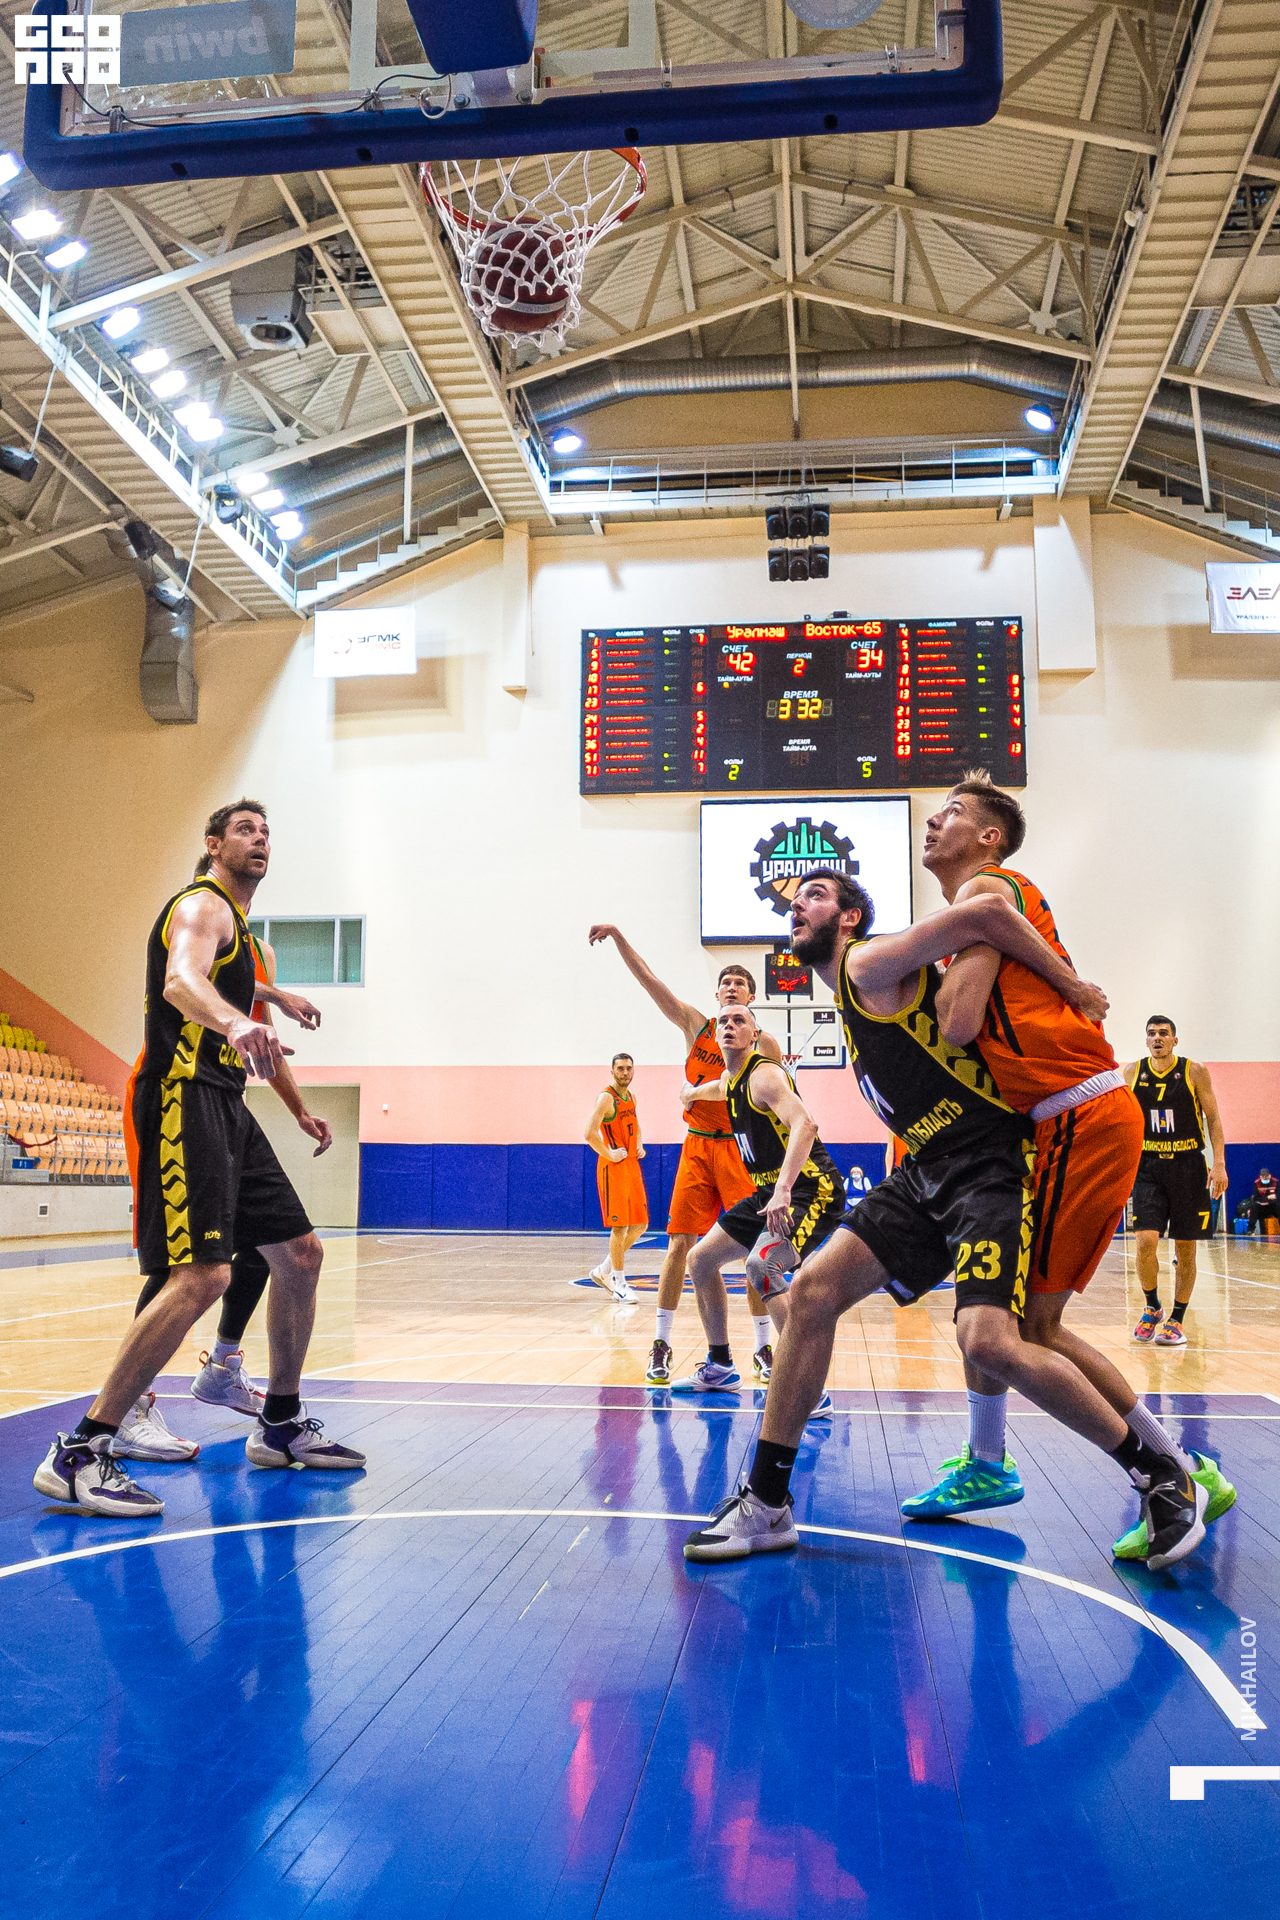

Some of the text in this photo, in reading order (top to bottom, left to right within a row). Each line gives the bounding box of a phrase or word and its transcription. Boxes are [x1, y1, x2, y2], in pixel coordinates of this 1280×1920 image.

[727, 622, 882, 638] Уралмаш Восток-65
[900, 628, 909, 639] 4
[1009, 625, 1018, 636] 2
[594, 637, 600, 647] 1
[698, 633, 705, 643] 7
[851, 641, 877, 649] СЧЕТ
[900, 640, 908, 650] 5
[591, 649, 599, 659] 5
[722, 645, 748, 653] СЧЕТ
[728, 652, 755, 672] 42
[858, 649, 884, 670] 34
[901, 652, 909, 662] 7
[591, 661, 599, 672] 9
[793, 658, 805, 675] 2
[900, 664, 909, 675] 8
[588, 673, 599, 683] 10
[898, 677, 910, 687] 11
[1010, 675, 1019, 686] 8
[588, 686, 600, 695] 17
[697, 682, 705, 693] 6
[783, 691, 818, 699] ВРЕМЯ
[898, 689, 910, 700] 13
[1011, 687, 1020, 698] 3
[585, 698, 600, 708] 23
[895, 706, 910, 717] 21
[1011, 704, 1020, 715] 4
[585, 715, 599, 725] 24
[697, 711, 705, 722] 5
[896, 719, 910, 730] 23
[1012, 717, 1020, 728] 4
[585, 727, 599, 737] 31
[697, 724, 705, 734] 2
[895, 731, 910, 743] 25
[585, 740, 599, 751] 36
[697, 737, 706, 747] 4
[896, 745, 911, 757] 63
[1010, 742, 1021, 754] 13
[585, 752, 599, 763] 51
[694, 750, 706, 760] 11
[586, 765, 599, 776] 71
[698, 762, 705, 773] 7
[728, 764, 740, 781] 2
[862, 762, 872, 778] 5
[1155, 1083, 1167, 1101] 7
[906, 1097, 964, 1145] ОБЛАСТЬ
[1198, 1211, 1210, 1230] 7
[956, 1240, 1002, 1284] 23
